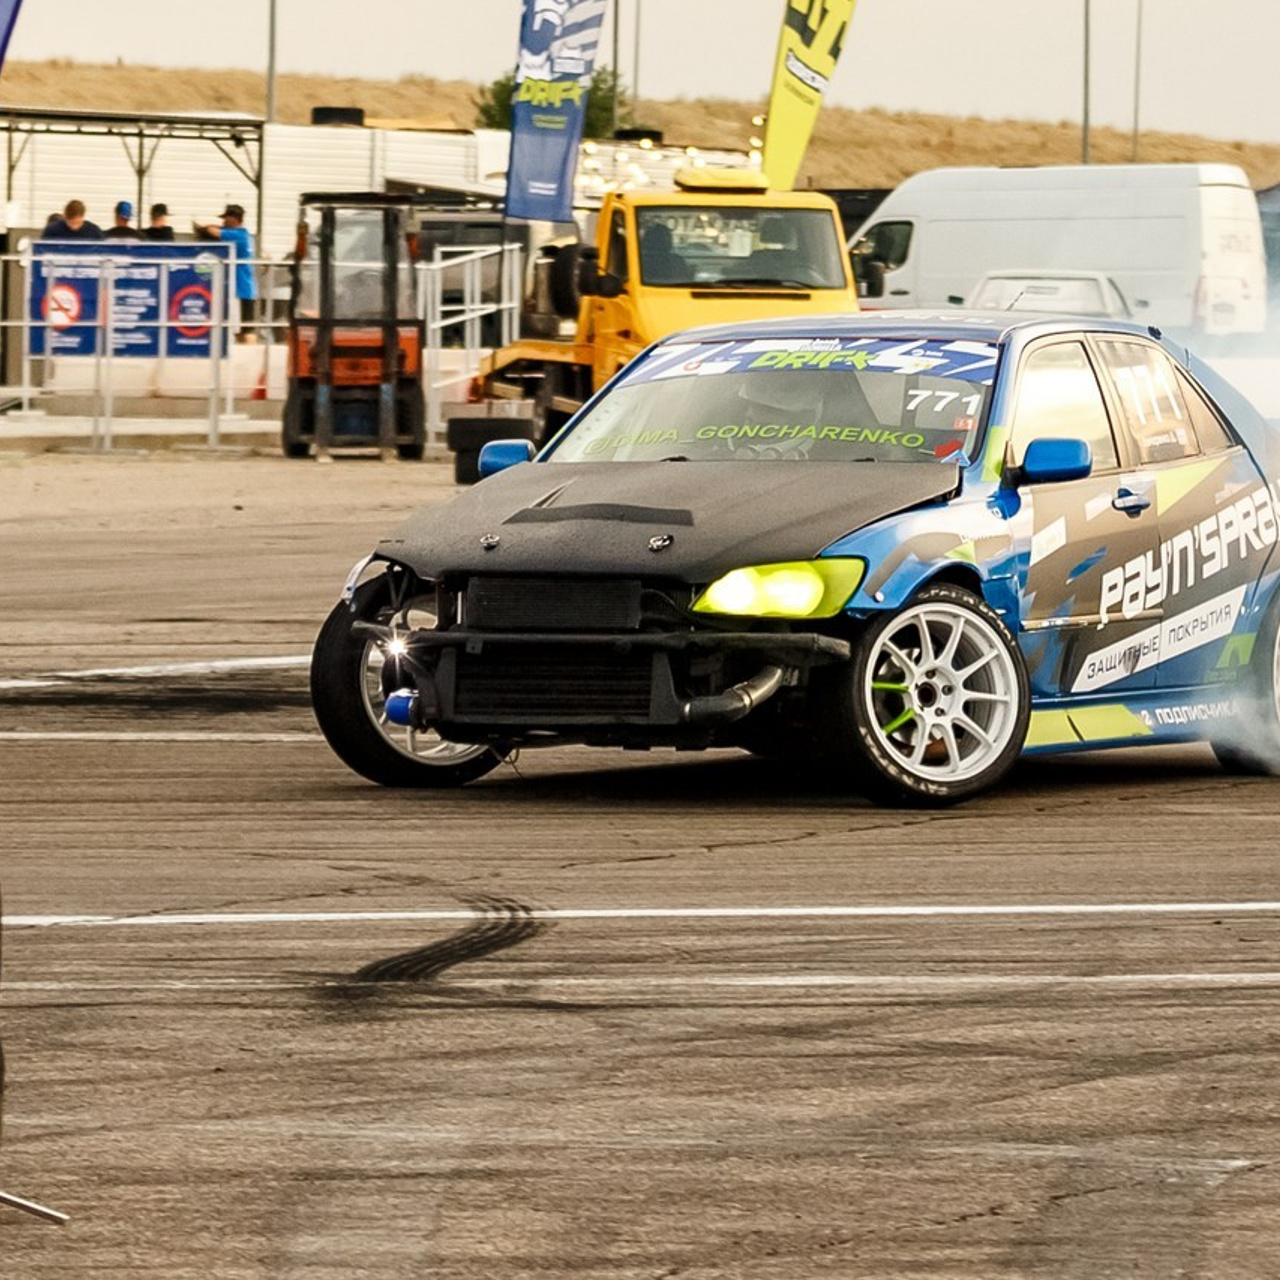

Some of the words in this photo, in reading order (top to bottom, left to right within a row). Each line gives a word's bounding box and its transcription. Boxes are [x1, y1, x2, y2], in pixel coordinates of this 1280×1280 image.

[906, 389, 981, 416] 771
[1087, 634, 1160, 680] ЗАЩИТНЫЕ
[1168, 604, 1232, 646] ПОКРЫТИЯ
